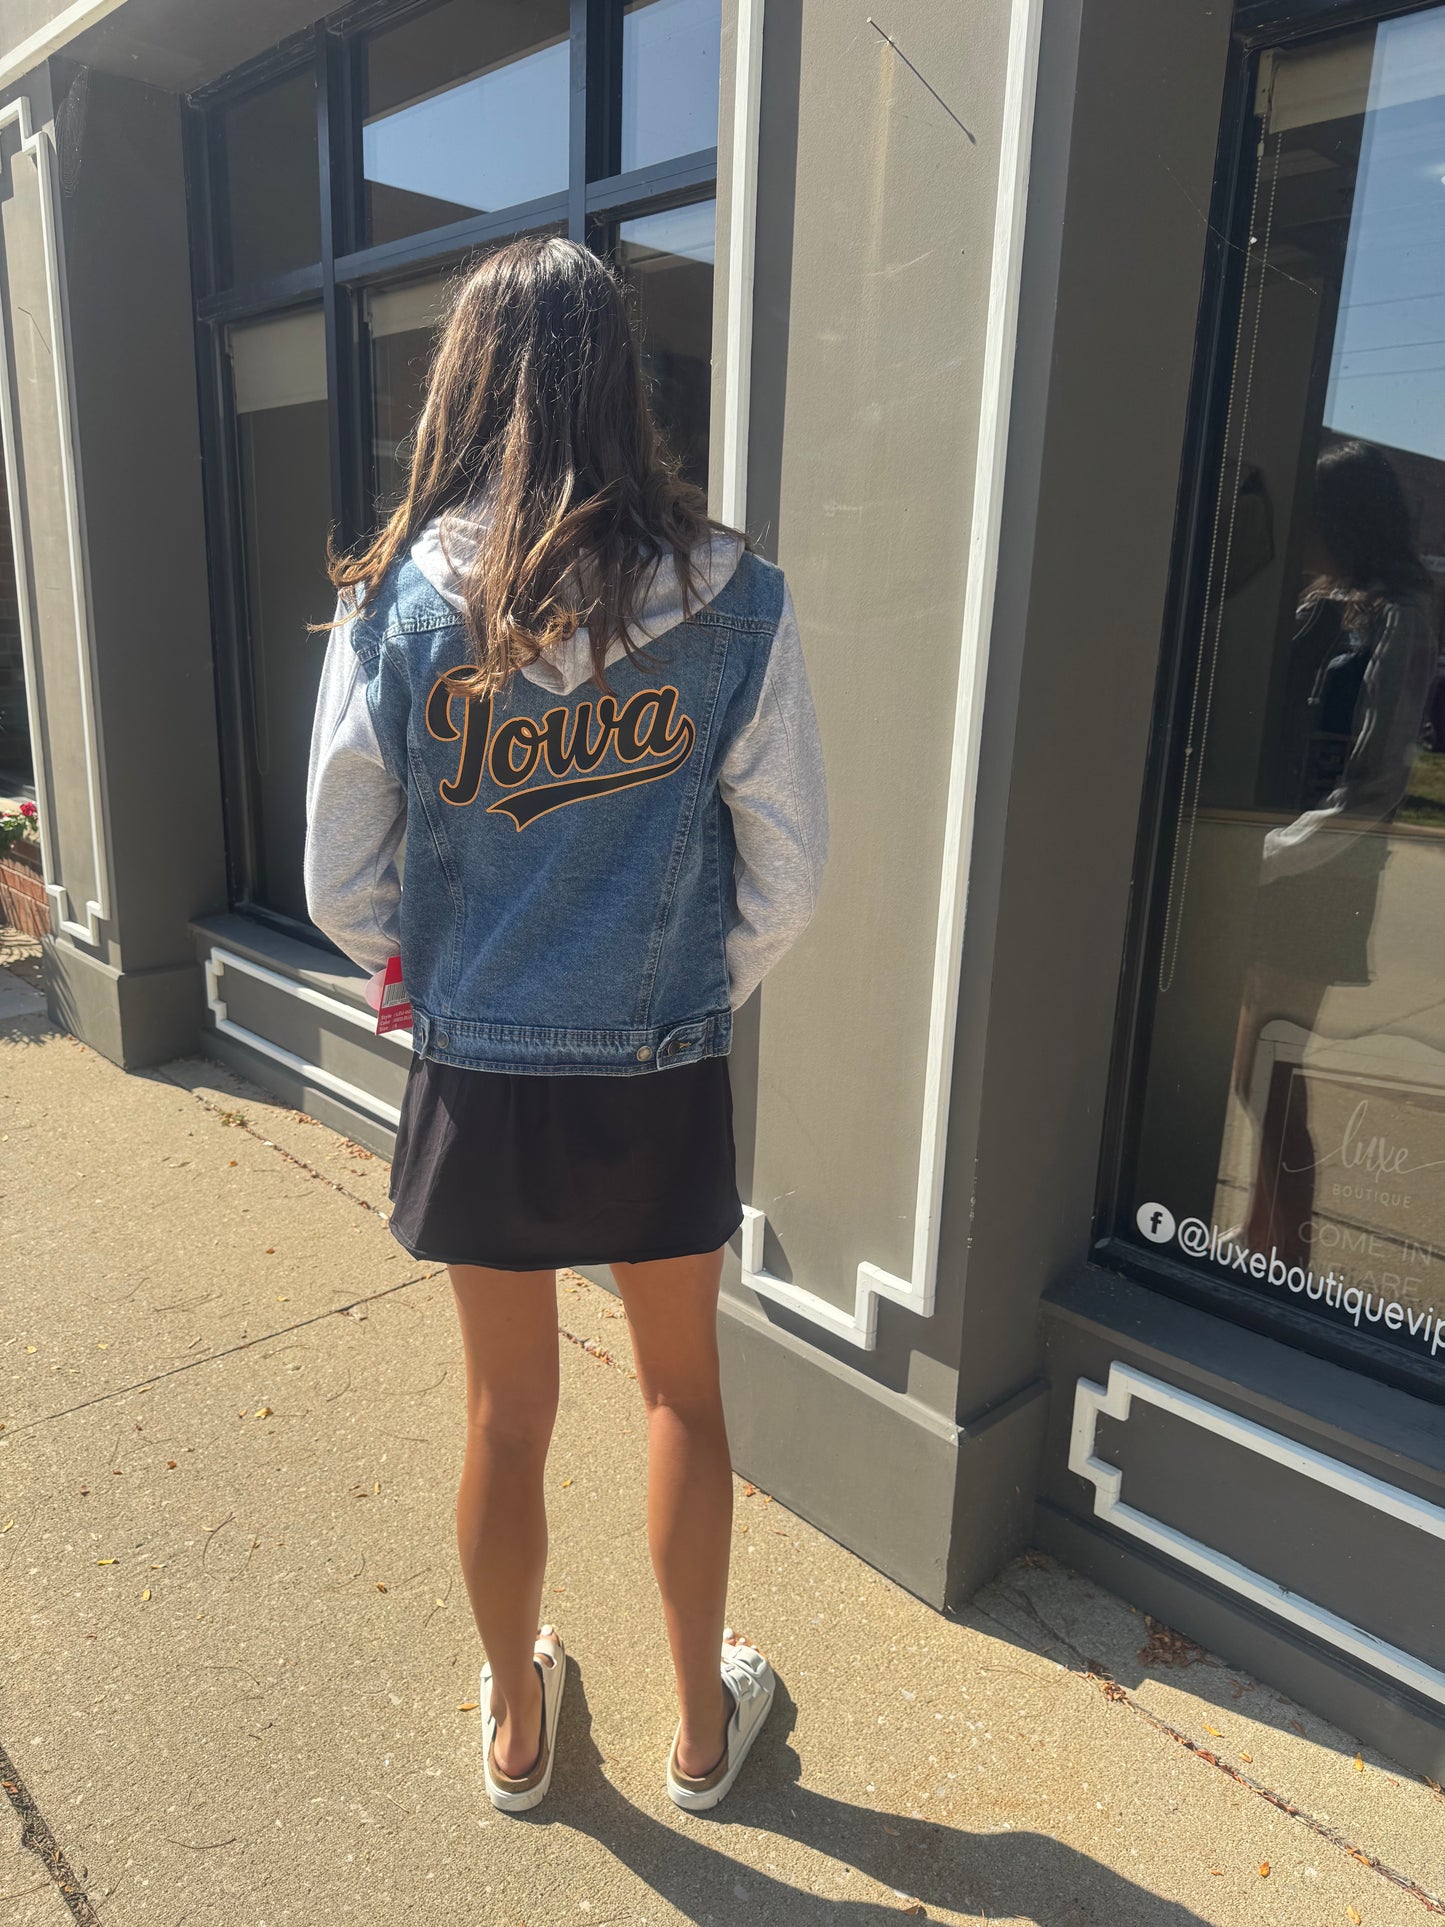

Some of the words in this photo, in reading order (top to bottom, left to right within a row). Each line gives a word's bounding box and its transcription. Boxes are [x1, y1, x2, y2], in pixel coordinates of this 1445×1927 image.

[425, 664, 697, 832] Iowa
[1332, 1184, 1412, 1209] BOUTIQUE
[1298, 1221, 1385, 1258] COME
[1402, 1240, 1433, 1265] IN
[1178, 1217, 1445, 1356] @luxeboutiquevip
[1360, 1270, 1423, 1302] ARE
